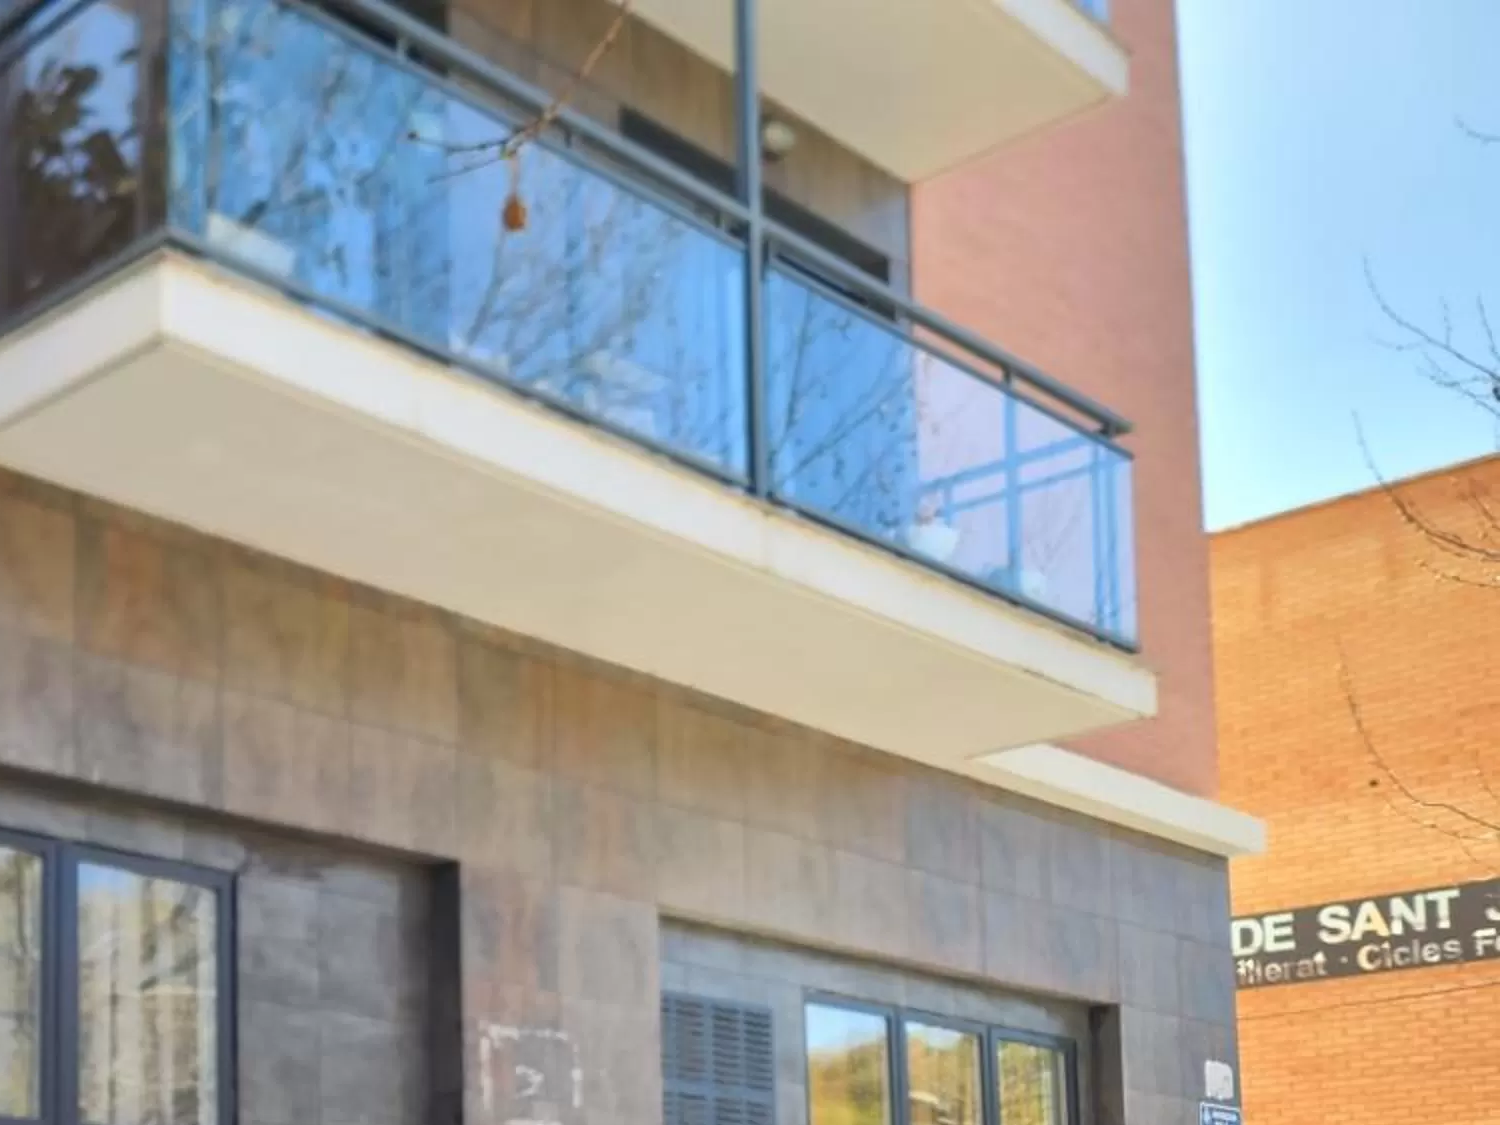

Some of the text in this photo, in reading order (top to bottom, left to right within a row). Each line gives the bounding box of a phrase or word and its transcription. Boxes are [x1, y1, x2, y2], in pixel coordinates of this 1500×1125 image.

[1231, 912, 1296, 956] DE
[1317, 888, 1460, 944] SANT
[1356, 939, 1463, 971] Cicles
